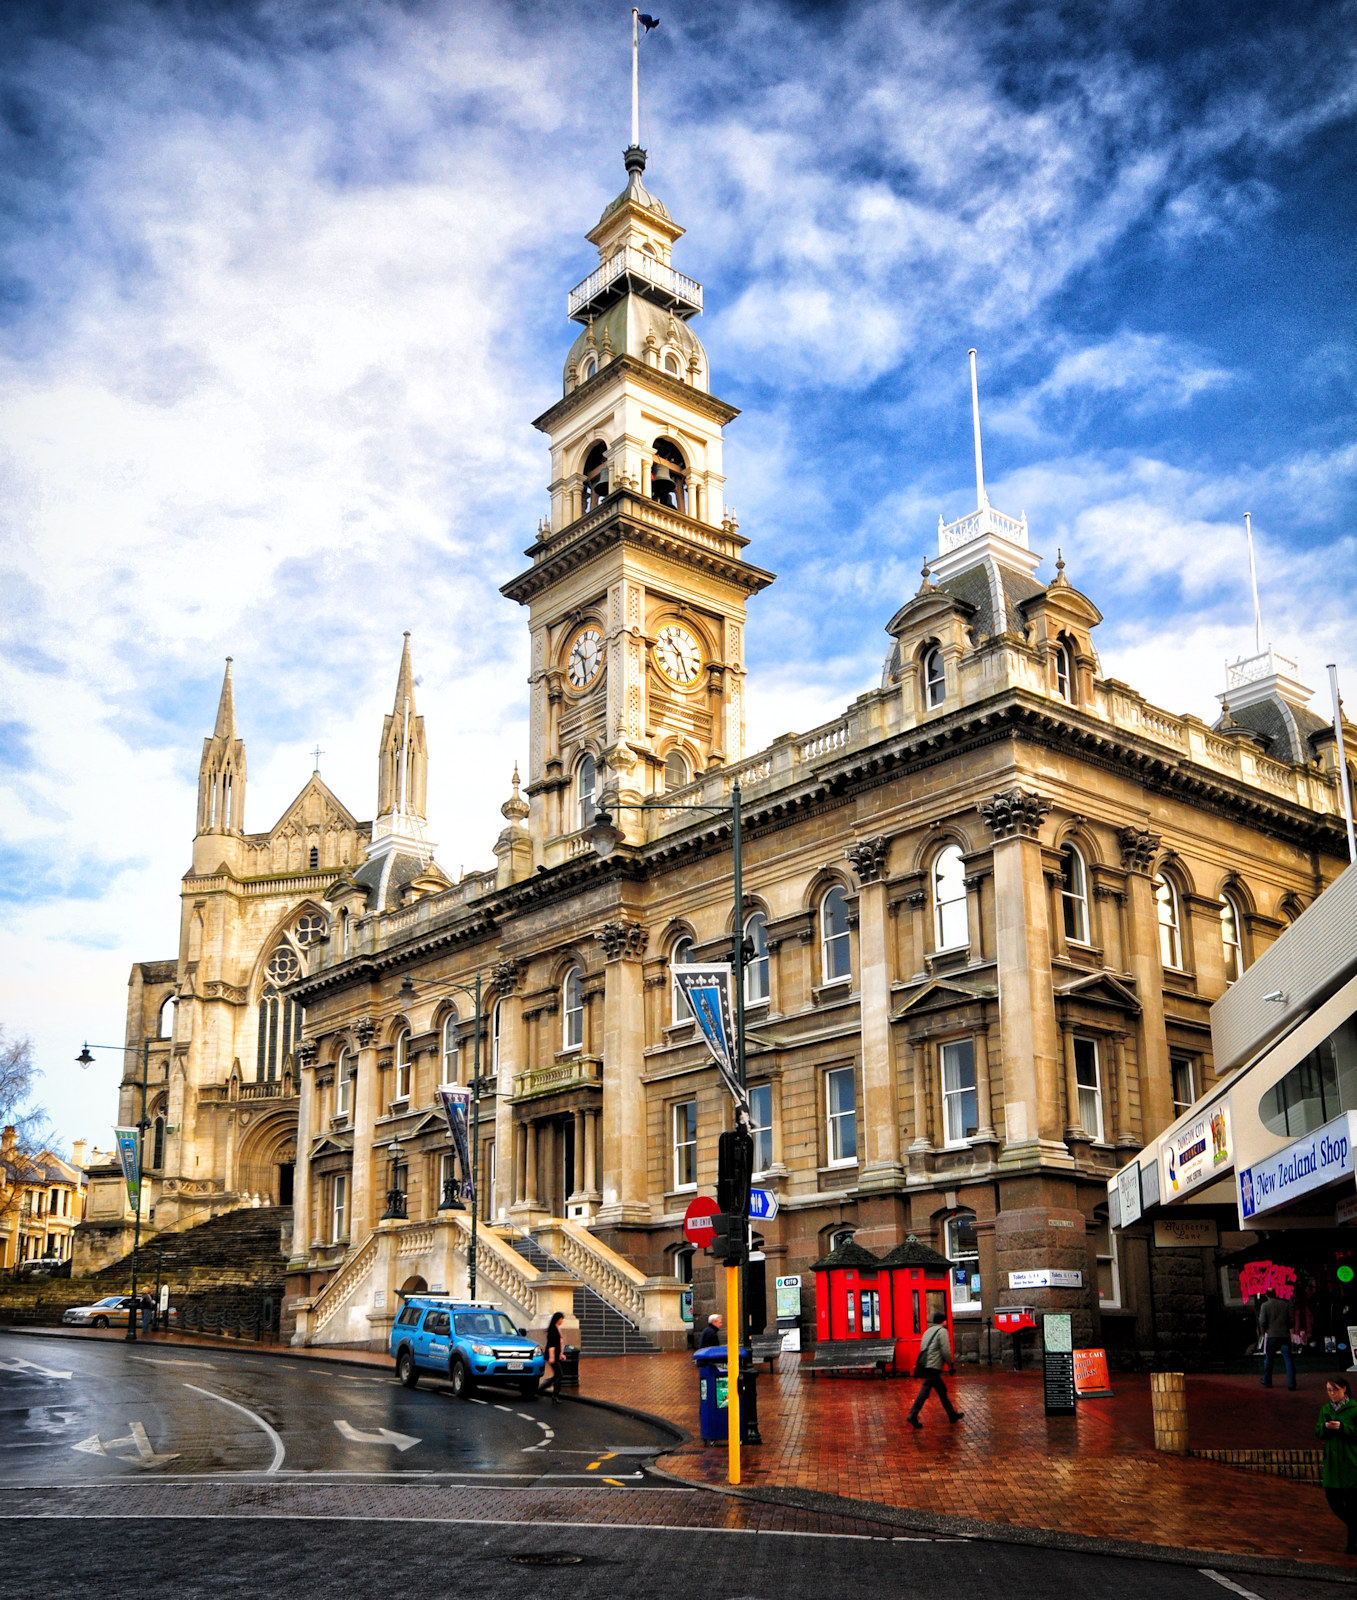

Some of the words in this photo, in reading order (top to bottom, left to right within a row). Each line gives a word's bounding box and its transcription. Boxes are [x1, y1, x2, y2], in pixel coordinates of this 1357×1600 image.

[1178, 1129, 1194, 1151] DUNEDIN
[1195, 1120, 1205, 1138] CITY
[1181, 1142, 1203, 1163] COUNCIL
[1256, 1171, 1276, 1206] New
[1278, 1142, 1318, 1189] Zealand
[1320, 1135, 1348, 1168] Shop
[692, 1219, 698, 1227] NO
[1271, 1264, 1297, 1284] 20%
